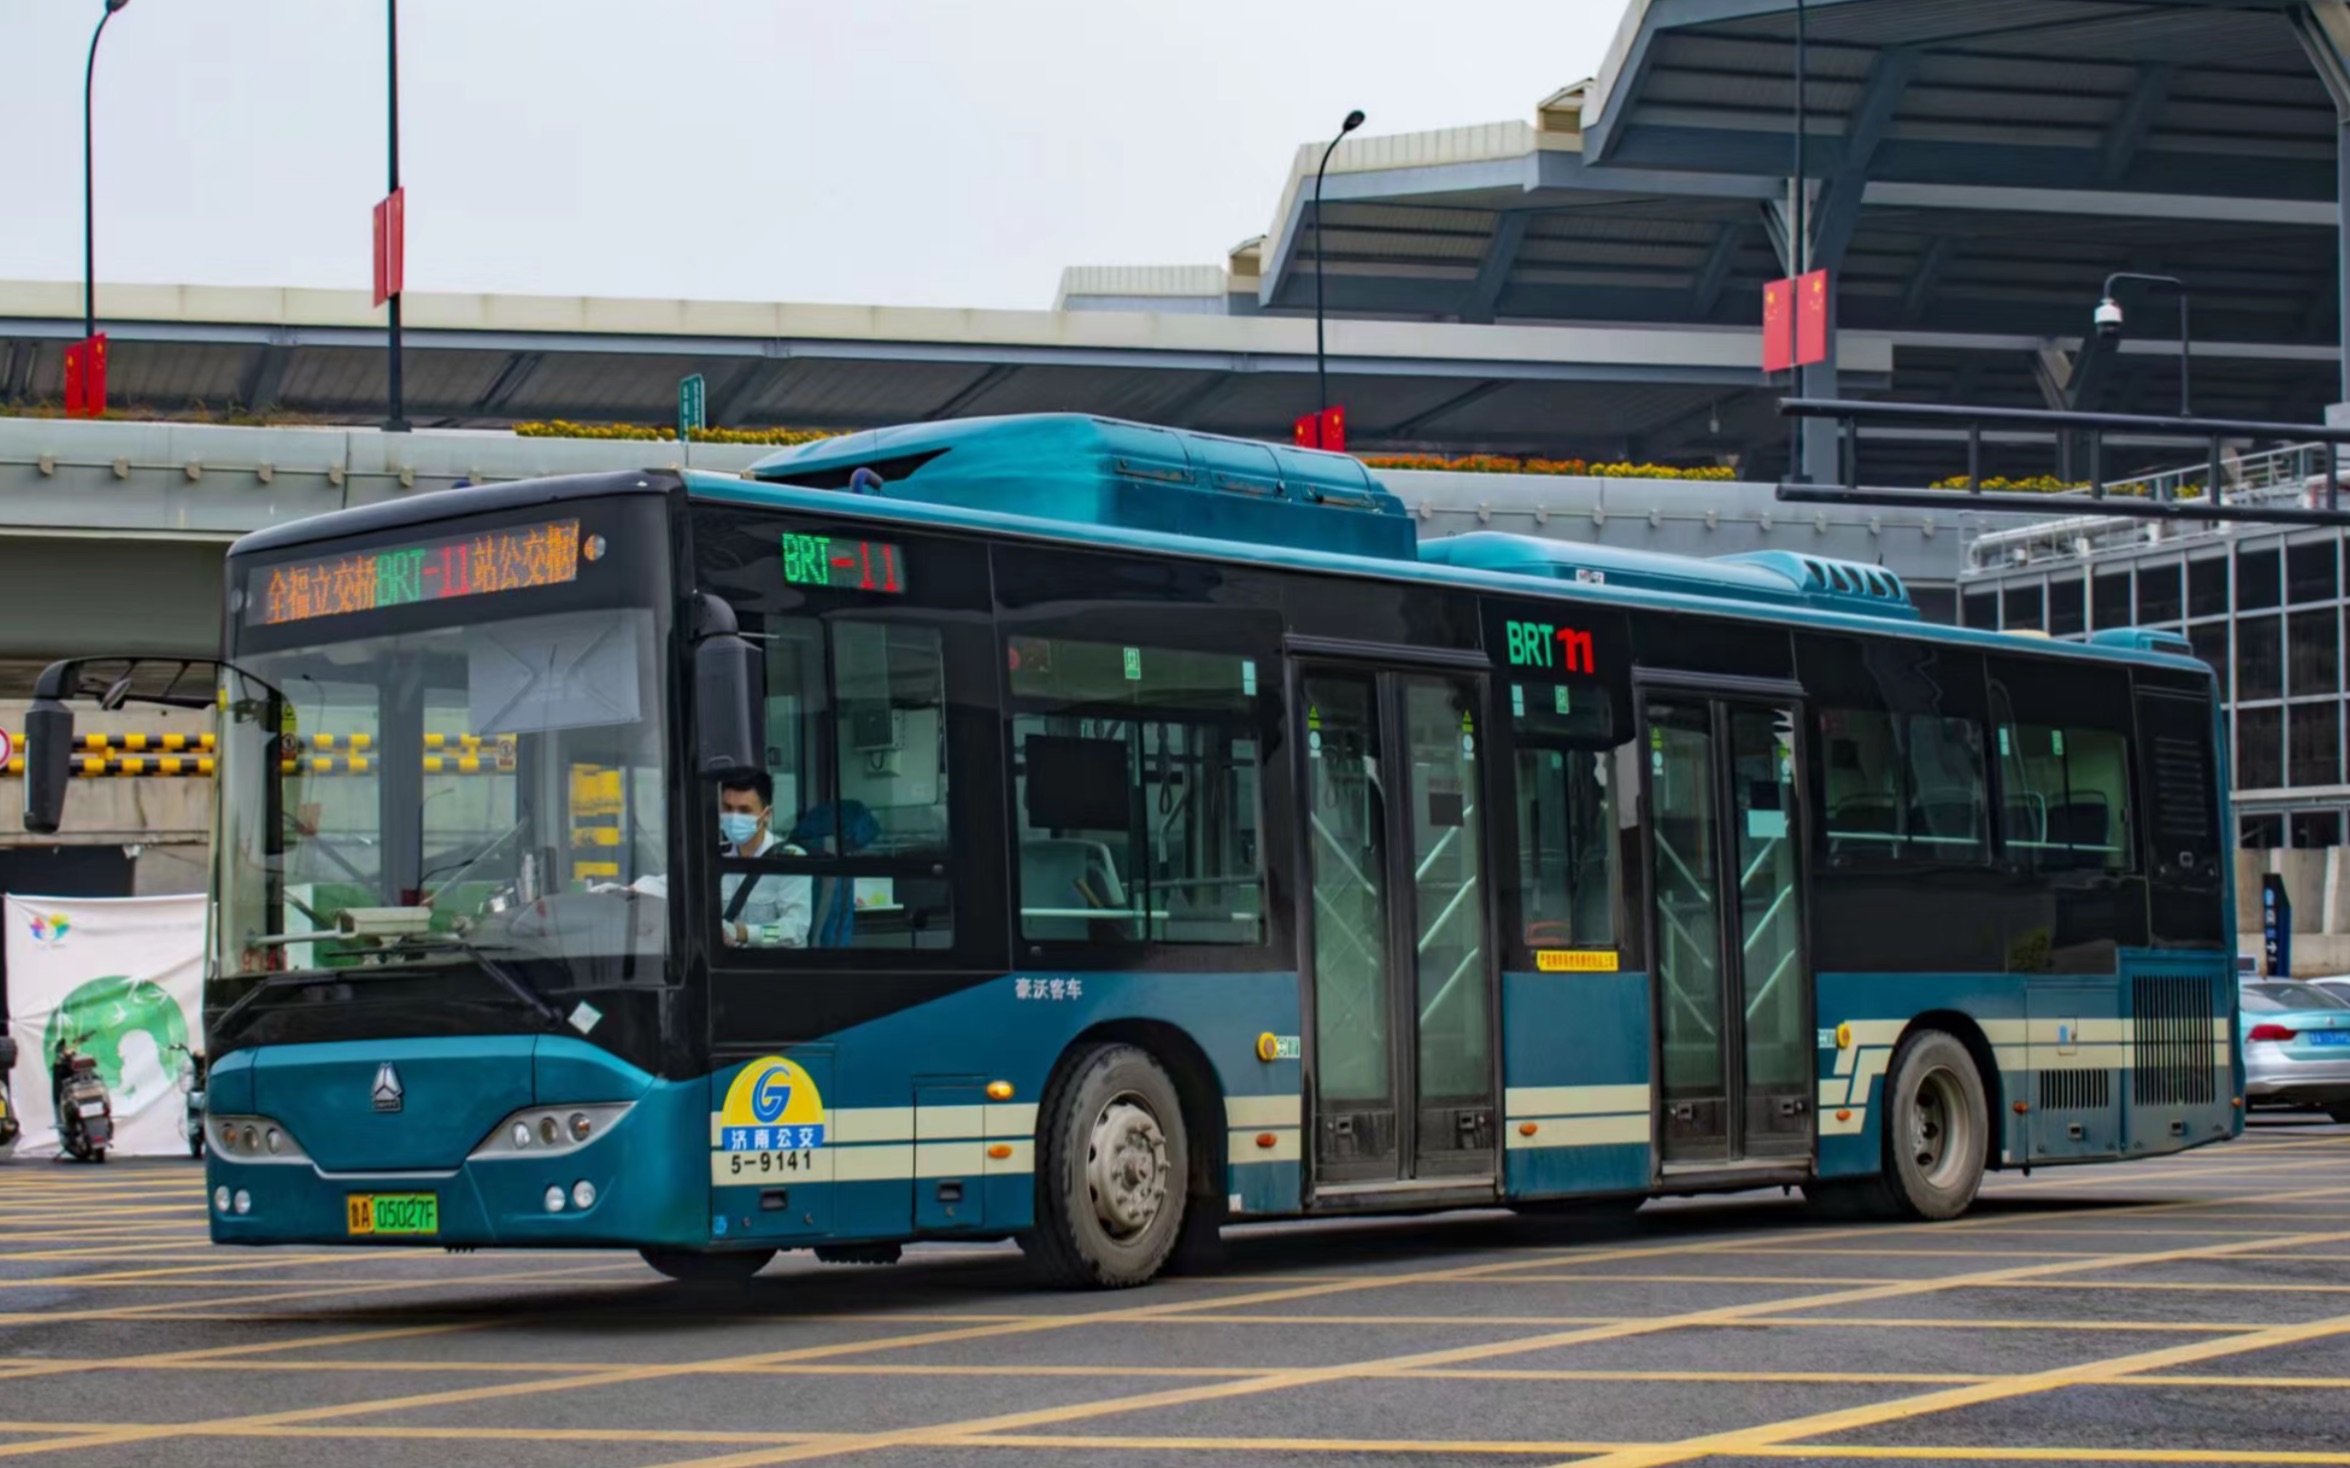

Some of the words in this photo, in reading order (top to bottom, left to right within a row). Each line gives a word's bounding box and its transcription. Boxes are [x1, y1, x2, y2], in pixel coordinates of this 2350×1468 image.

[731, 1127, 814, 1150] 济南公交
[731, 1149, 811, 1175] 5-9141
